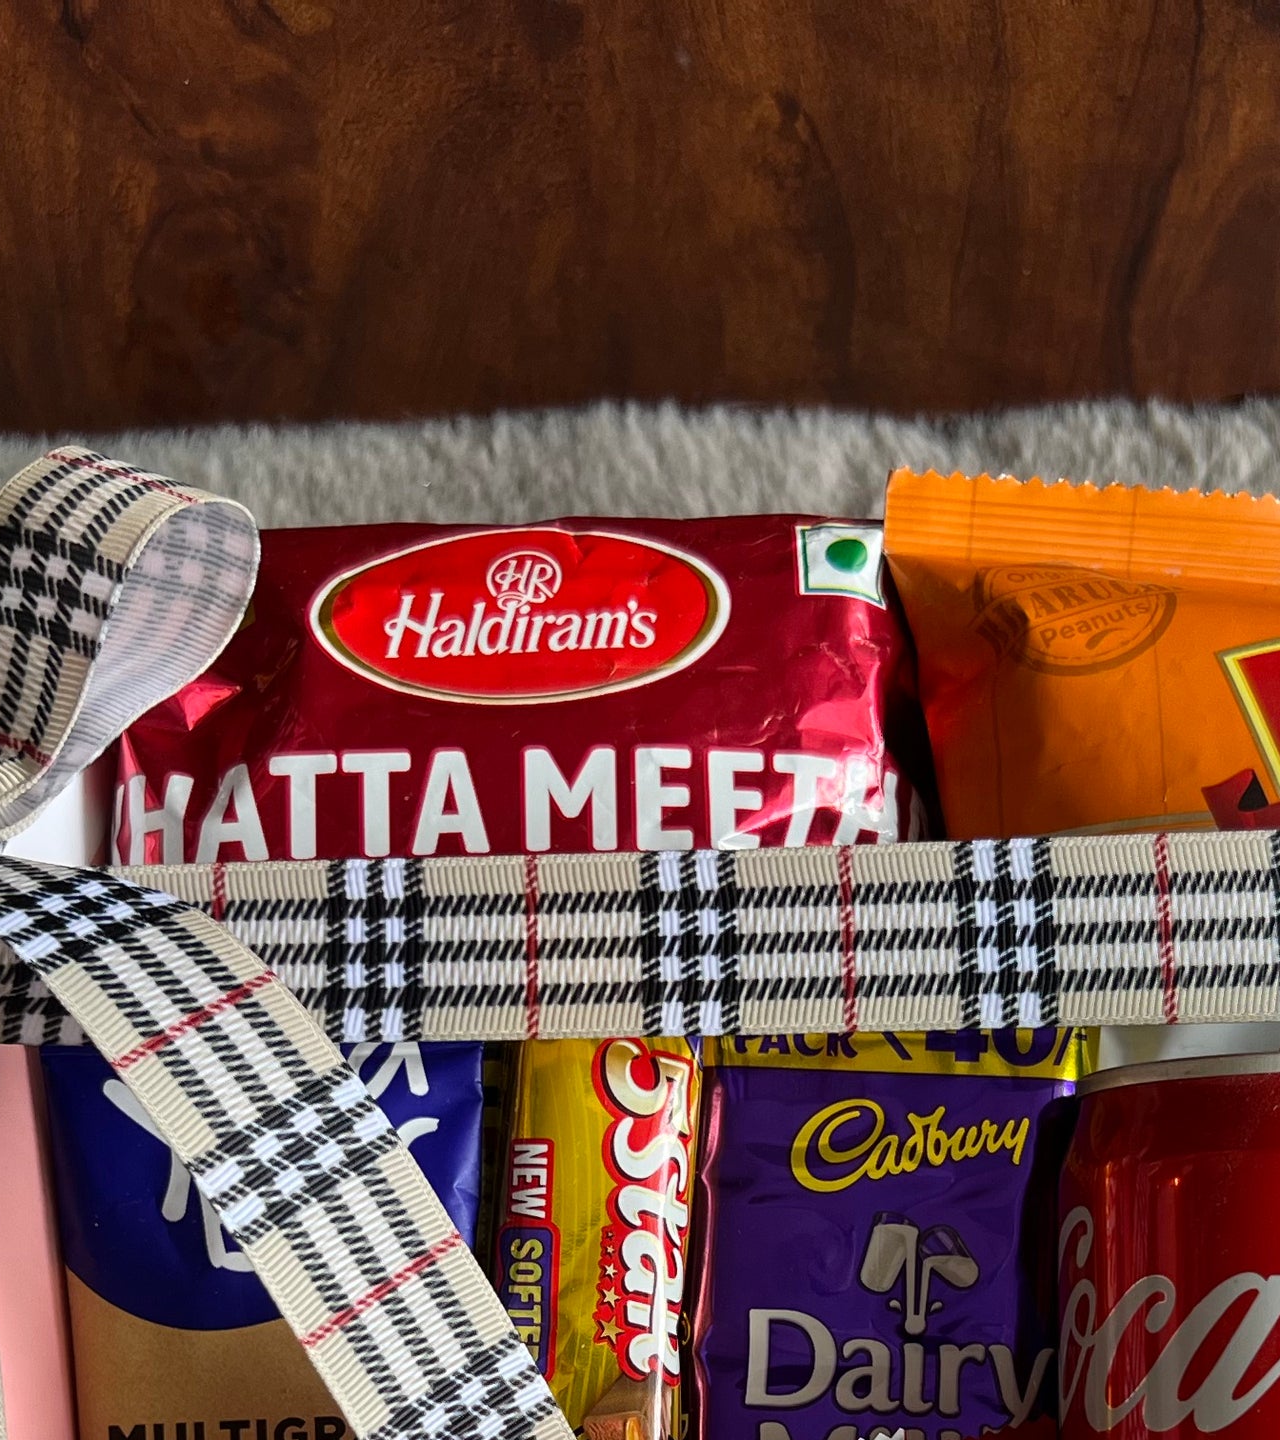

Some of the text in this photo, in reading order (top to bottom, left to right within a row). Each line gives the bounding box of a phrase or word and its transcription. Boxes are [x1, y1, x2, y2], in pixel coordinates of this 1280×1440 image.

[383, 592, 659, 660] Haldiram's
[1039, 599, 1150, 649] Peanuts
[111, 747, 928, 866] HATTA MEETH
[511, 1143, 548, 1219] NEW
[790, 1099, 1030, 1193] Cadbury
[743, 1307, 1054, 1430] Dairy
